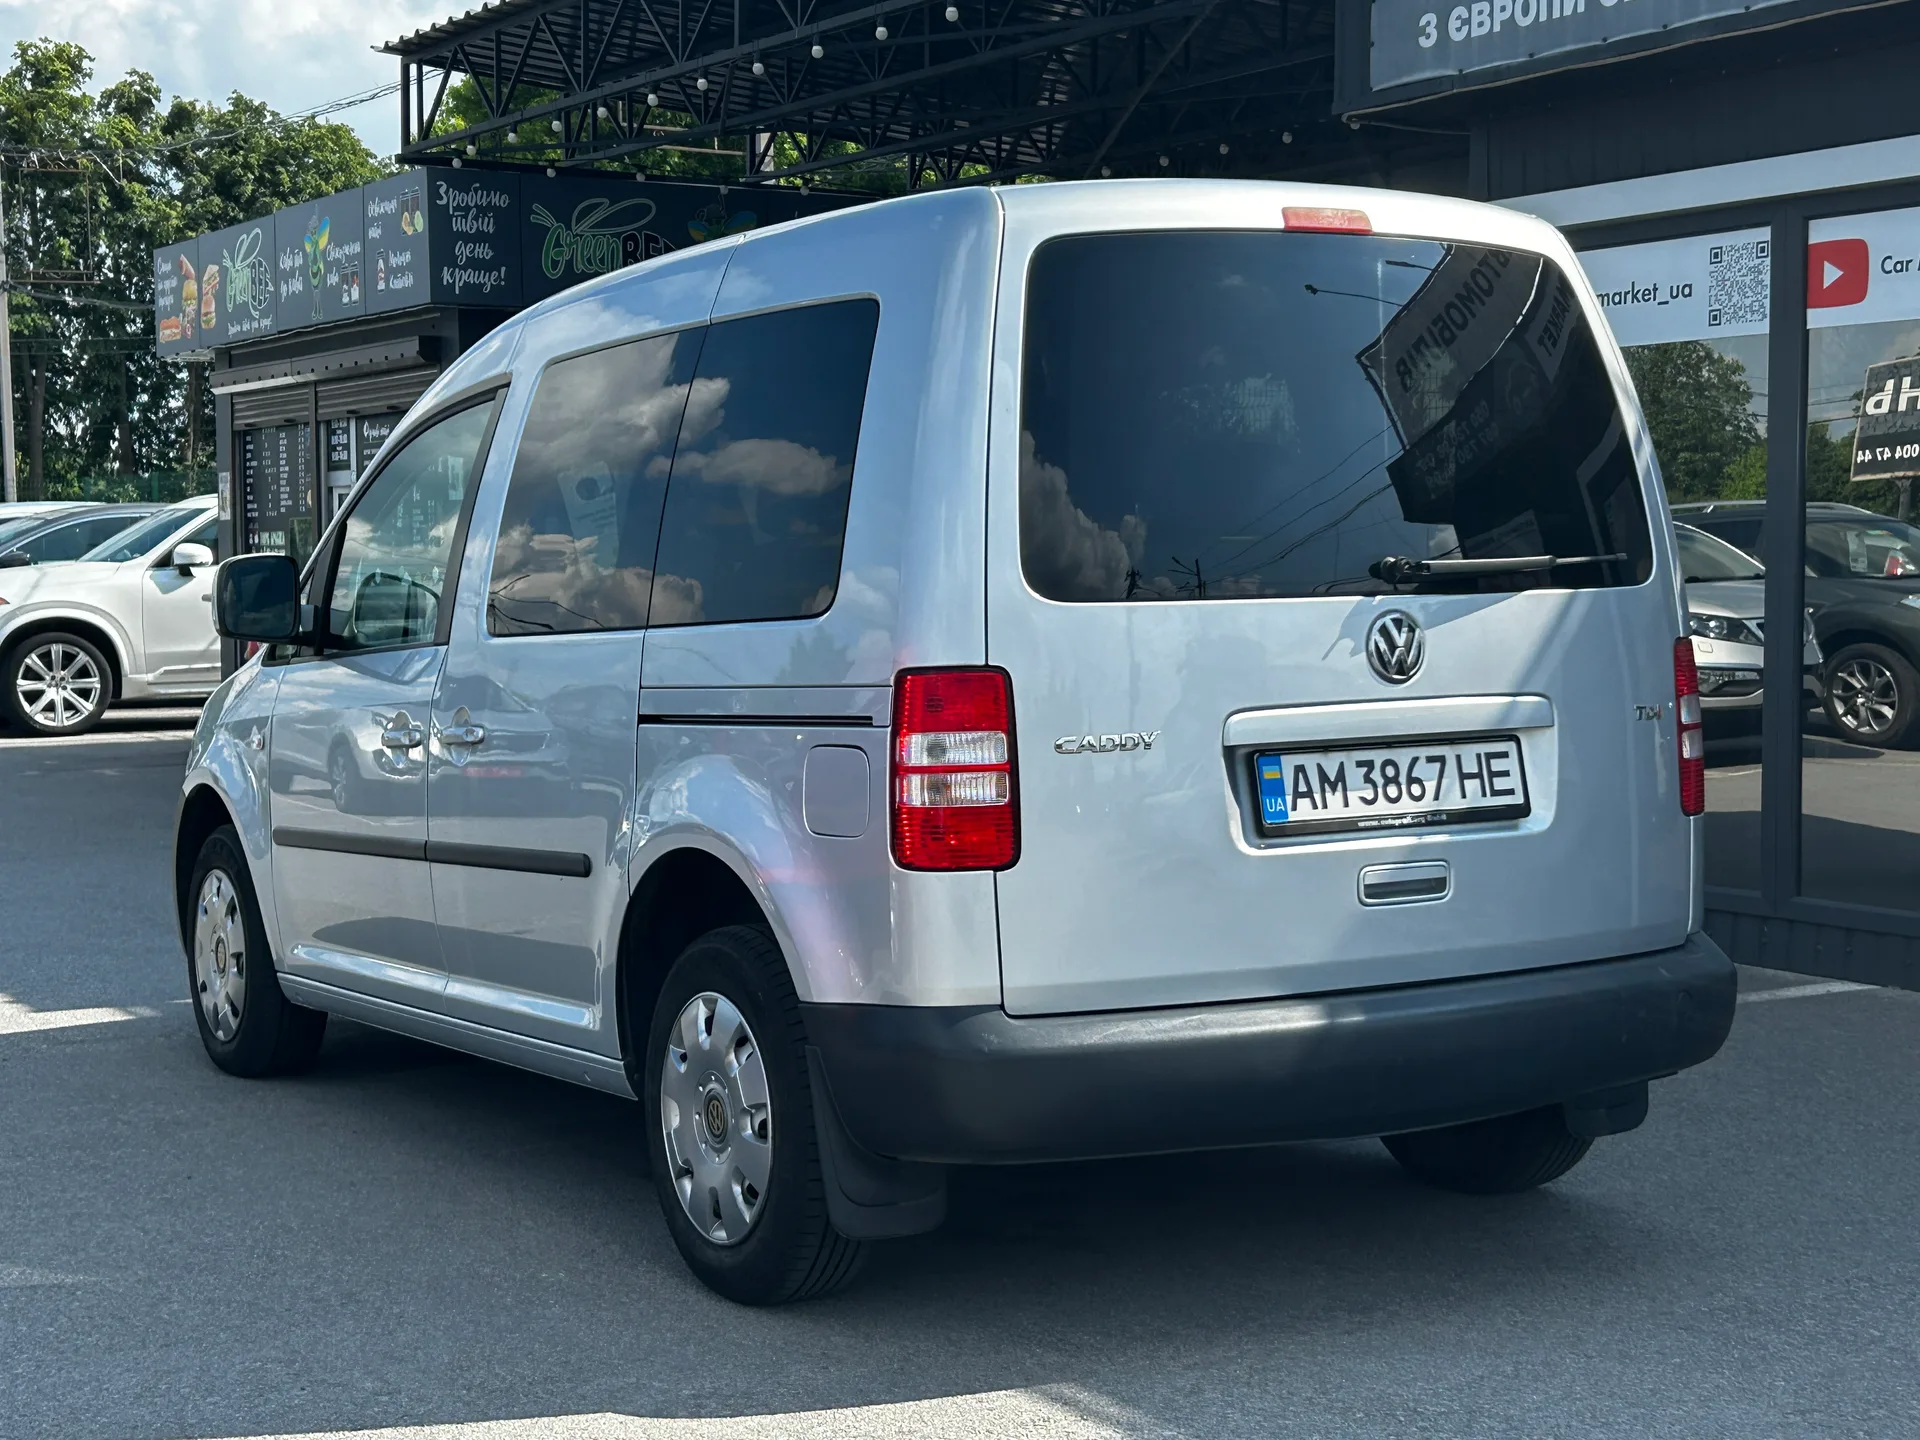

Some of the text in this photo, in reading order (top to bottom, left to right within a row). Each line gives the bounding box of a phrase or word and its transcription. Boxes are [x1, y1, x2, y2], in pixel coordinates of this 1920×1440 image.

[436, 181, 510, 214] Зробимо
[452, 208, 495, 234] твій
[455, 240, 494, 265] день
[541, 222, 677, 280] GreenBE
[1880, 254, 1914, 275] Car
[441, 266, 506, 294] краще!
[1053, 730, 1162, 755] CADDY
[1290, 750, 1516, 812] AM 3867 HE
[1266, 797, 1286, 813] UA
